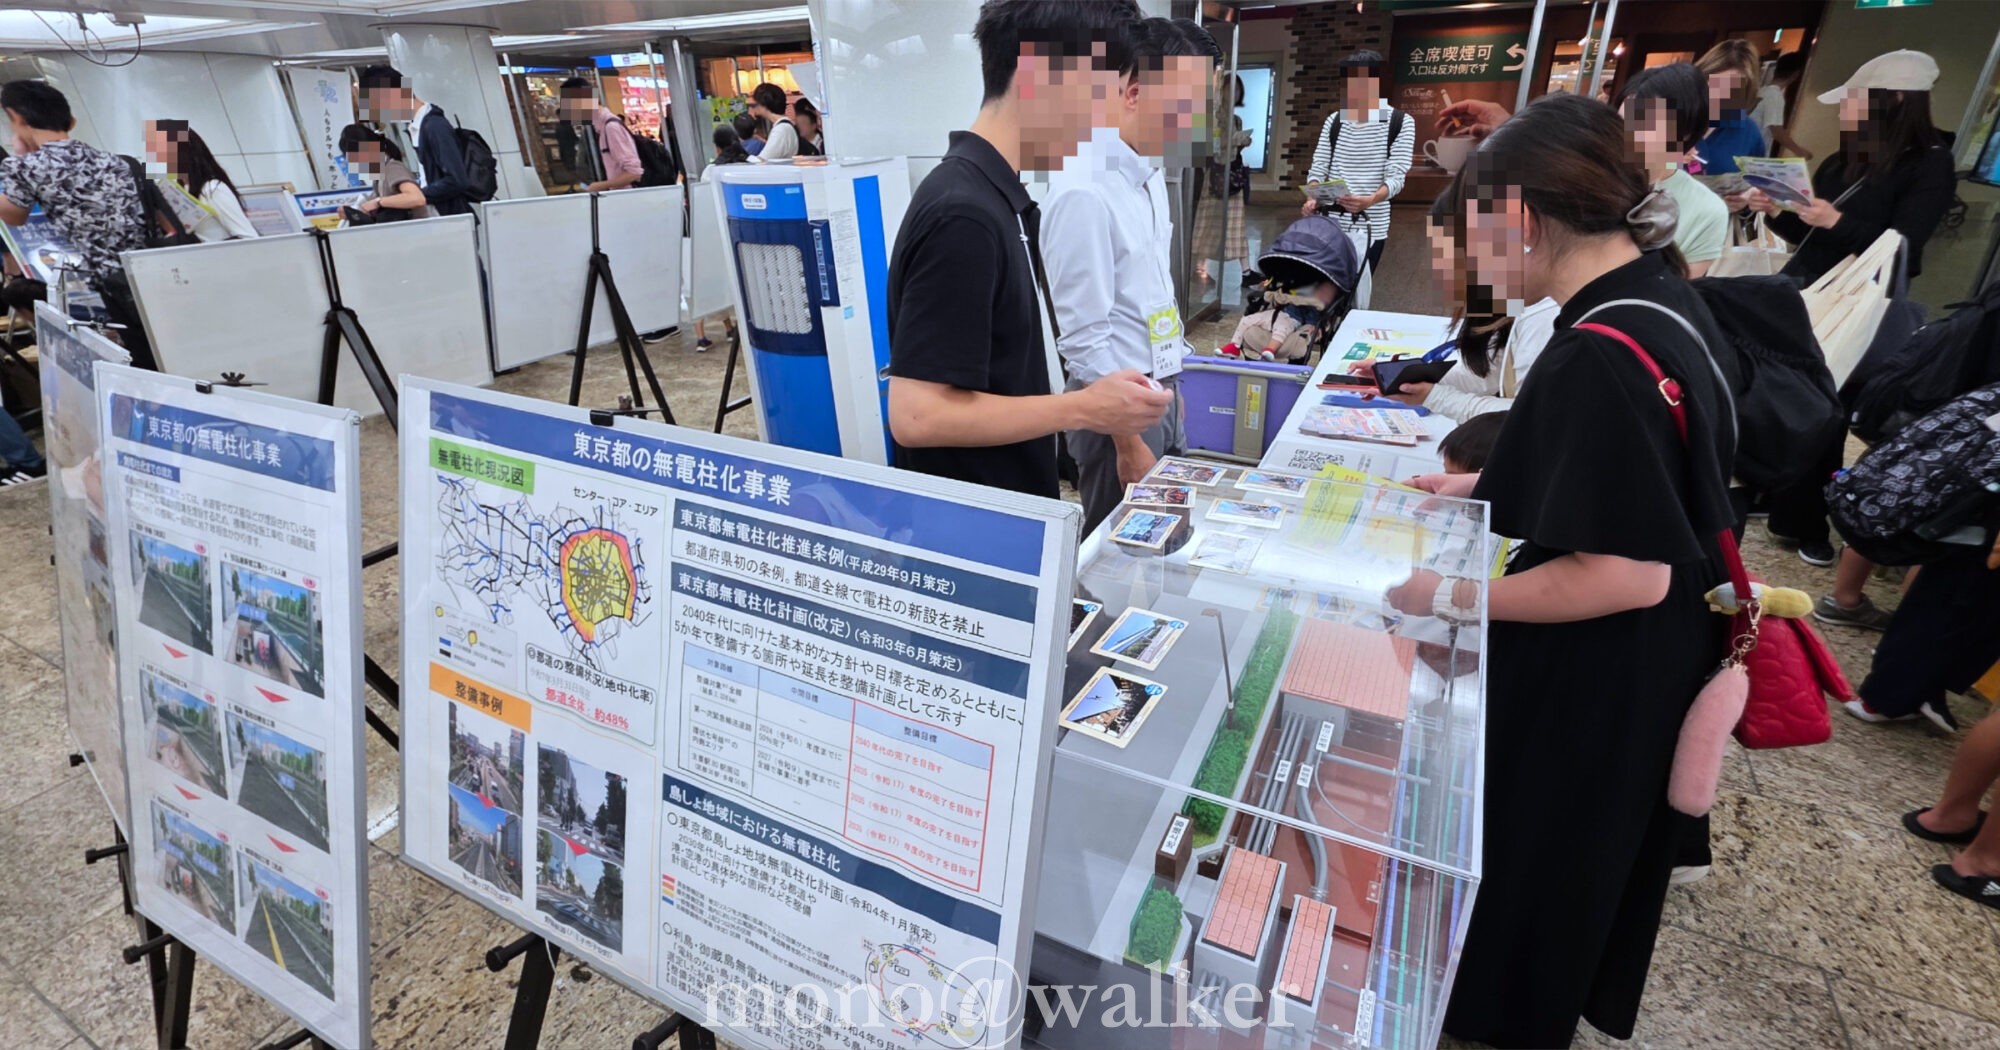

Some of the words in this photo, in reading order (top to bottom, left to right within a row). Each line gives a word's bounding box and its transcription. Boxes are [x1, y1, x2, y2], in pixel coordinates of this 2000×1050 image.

[1408, 63, 1489, 77] 入口は反対側です
[1409, 44, 1494, 64] 全席喫煙可
[146, 414, 283, 468] 東京都の無電柱化事業
[437, 447, 525, 488] 無電柱化現況図
[573, 430, 792, 507] 東京都の無電柱化事業
[684, 540, 986, 639] 都道府県初の条例。都道全線で電柱の新設を禁止
[674, 620, 967, 727] 5か年で整備する箇所や延長を整備計画として示す
[682, 604, 1025, 726] 2040年代に向けた基本的な方針や目標を定めるとともに、
[455, 679, 504, 716] 整備事例
[903, 726, 938, 743] 整備目標
[669, 784, 841, 873] 島しょ地域における無電柱化
[671, 857, 728, 890] 計画として示す
